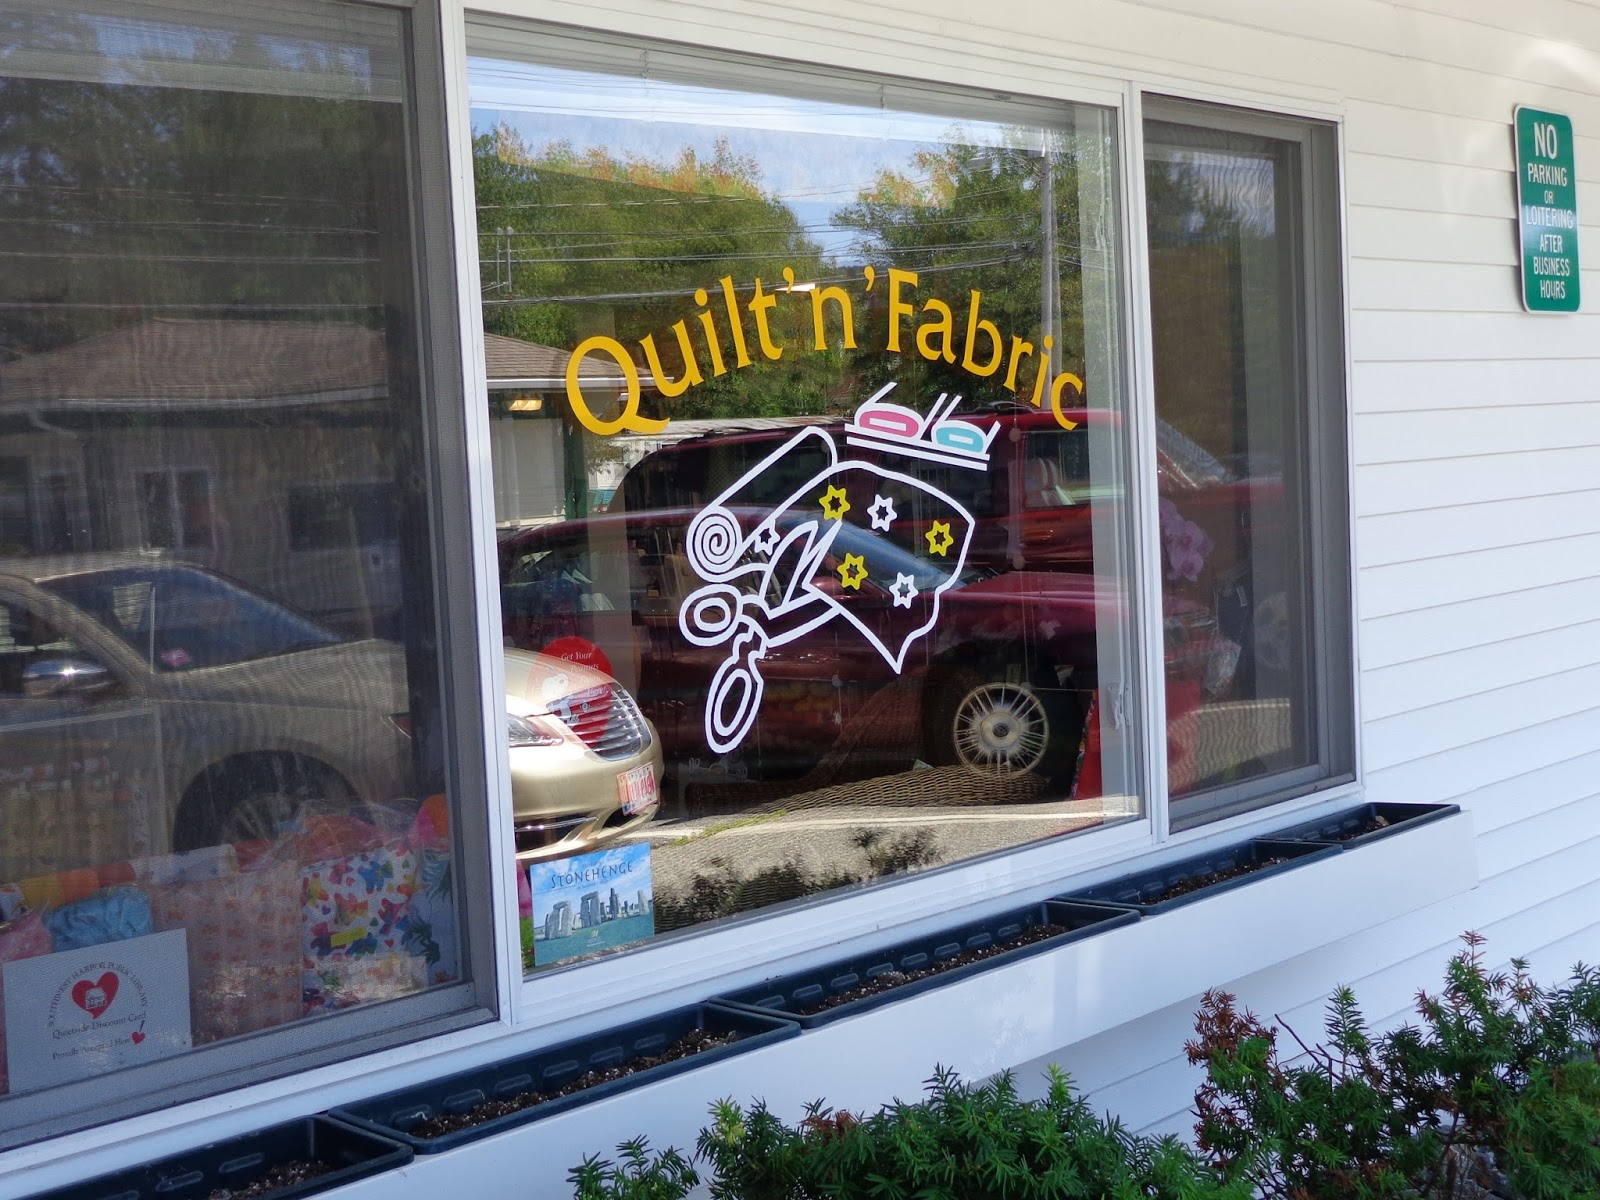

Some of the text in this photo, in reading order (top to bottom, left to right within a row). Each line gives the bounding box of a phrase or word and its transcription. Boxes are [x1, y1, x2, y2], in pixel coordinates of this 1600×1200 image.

[1533, 121, 1558, 160] NO
[1527, 162, 1568, 187] PARKING
[1543, 190, 1554, 205] OR
[1525, 205, 1574, 229] LOITERING
[1539, 234, 1563, 254] AFTER
[1533, 256, 1570, 277] BUSINESS
[1540, 279, 1565, 300] HOURS
[560, 651, 593, 662] Get Your
[551, 860, 633, 889] STONEHENGE
[127, 1011, 147, 1022] Card
